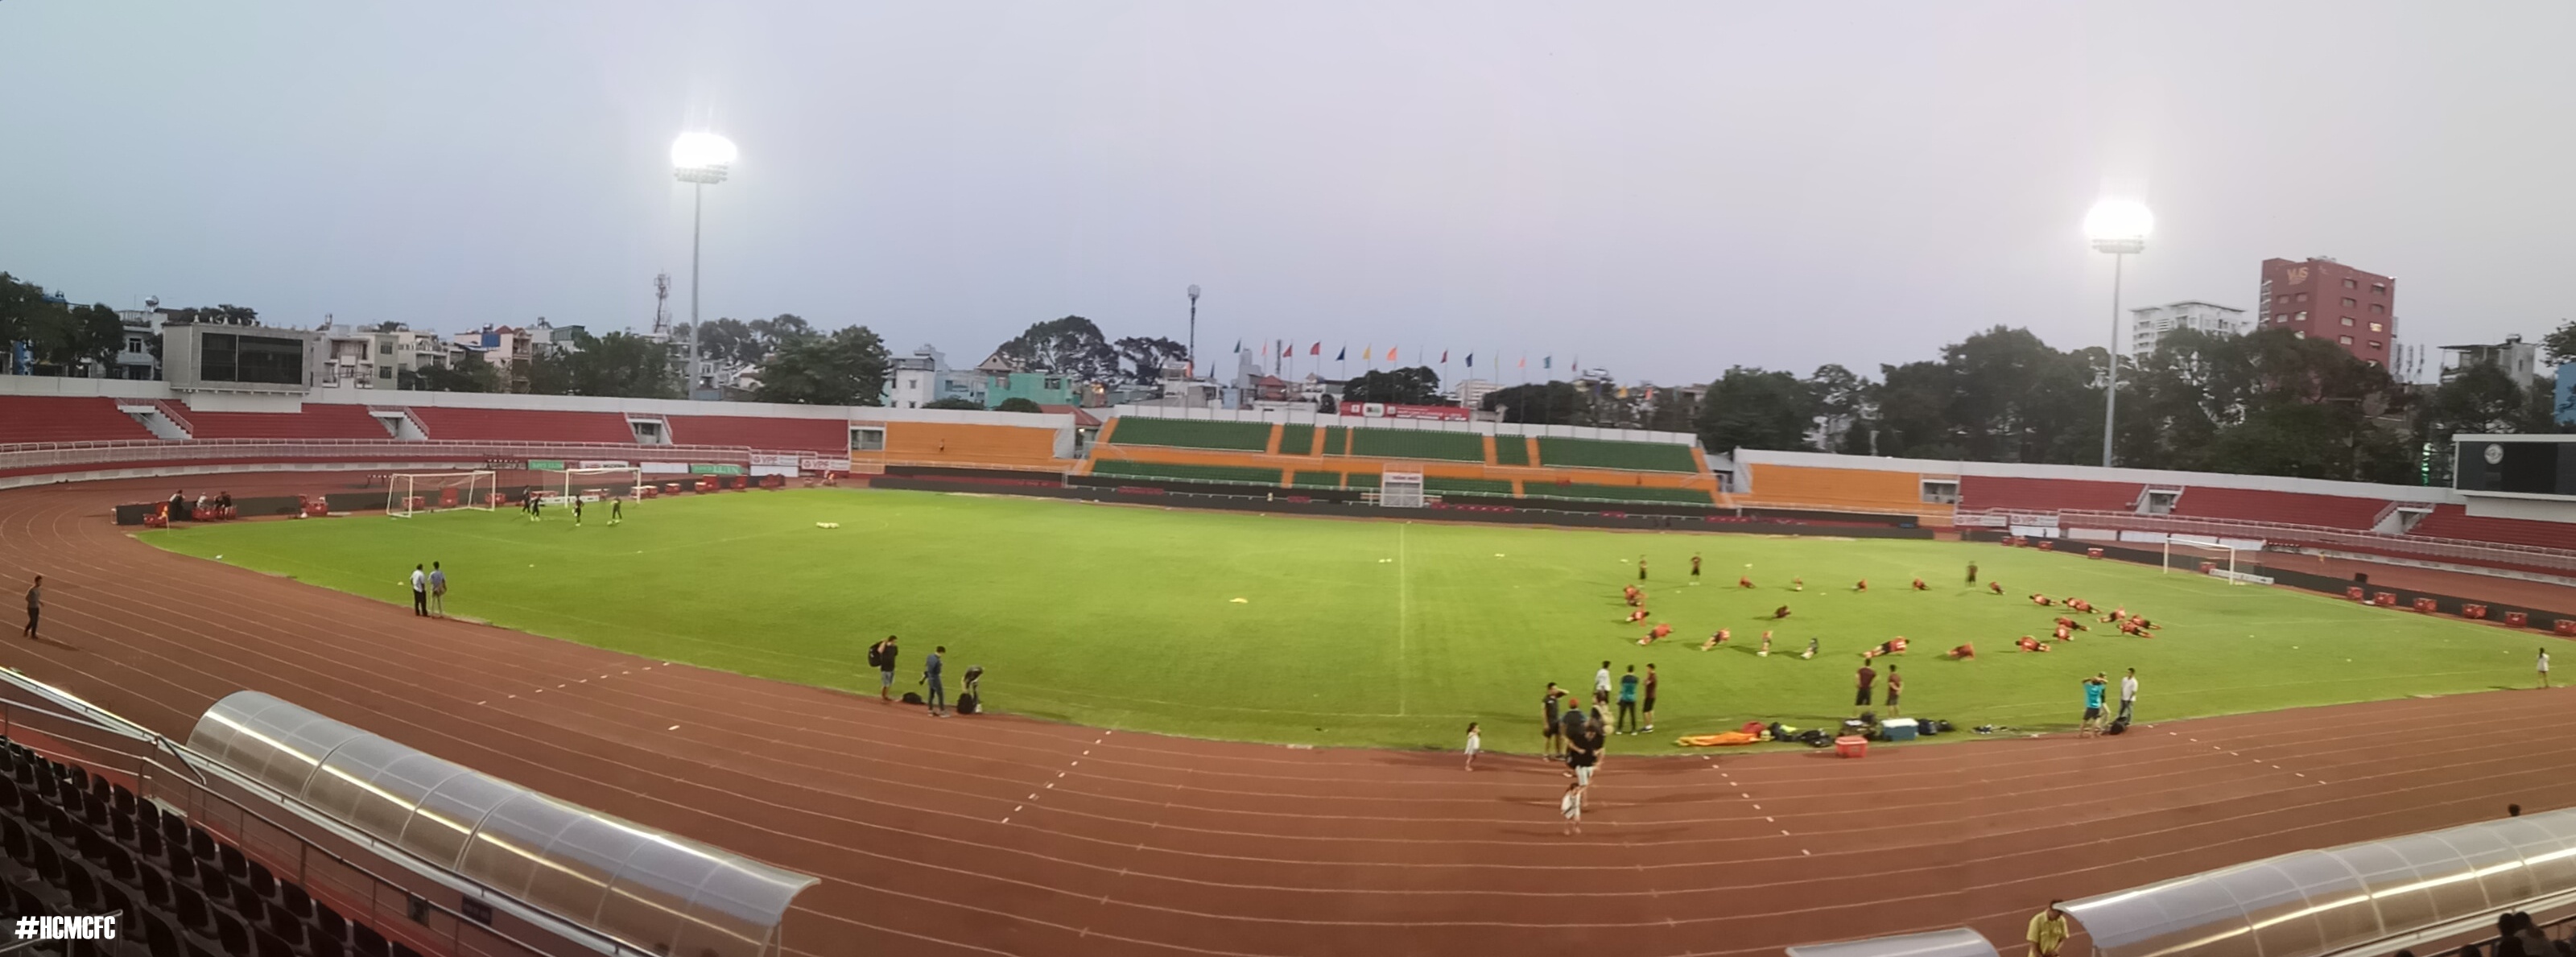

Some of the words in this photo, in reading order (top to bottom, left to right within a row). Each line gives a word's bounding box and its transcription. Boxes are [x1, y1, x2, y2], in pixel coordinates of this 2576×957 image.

[2287, 266, 2309, 280] VUS
[761, 456, 778, 465] VPF
[813, 460, 829, 469] VPF
